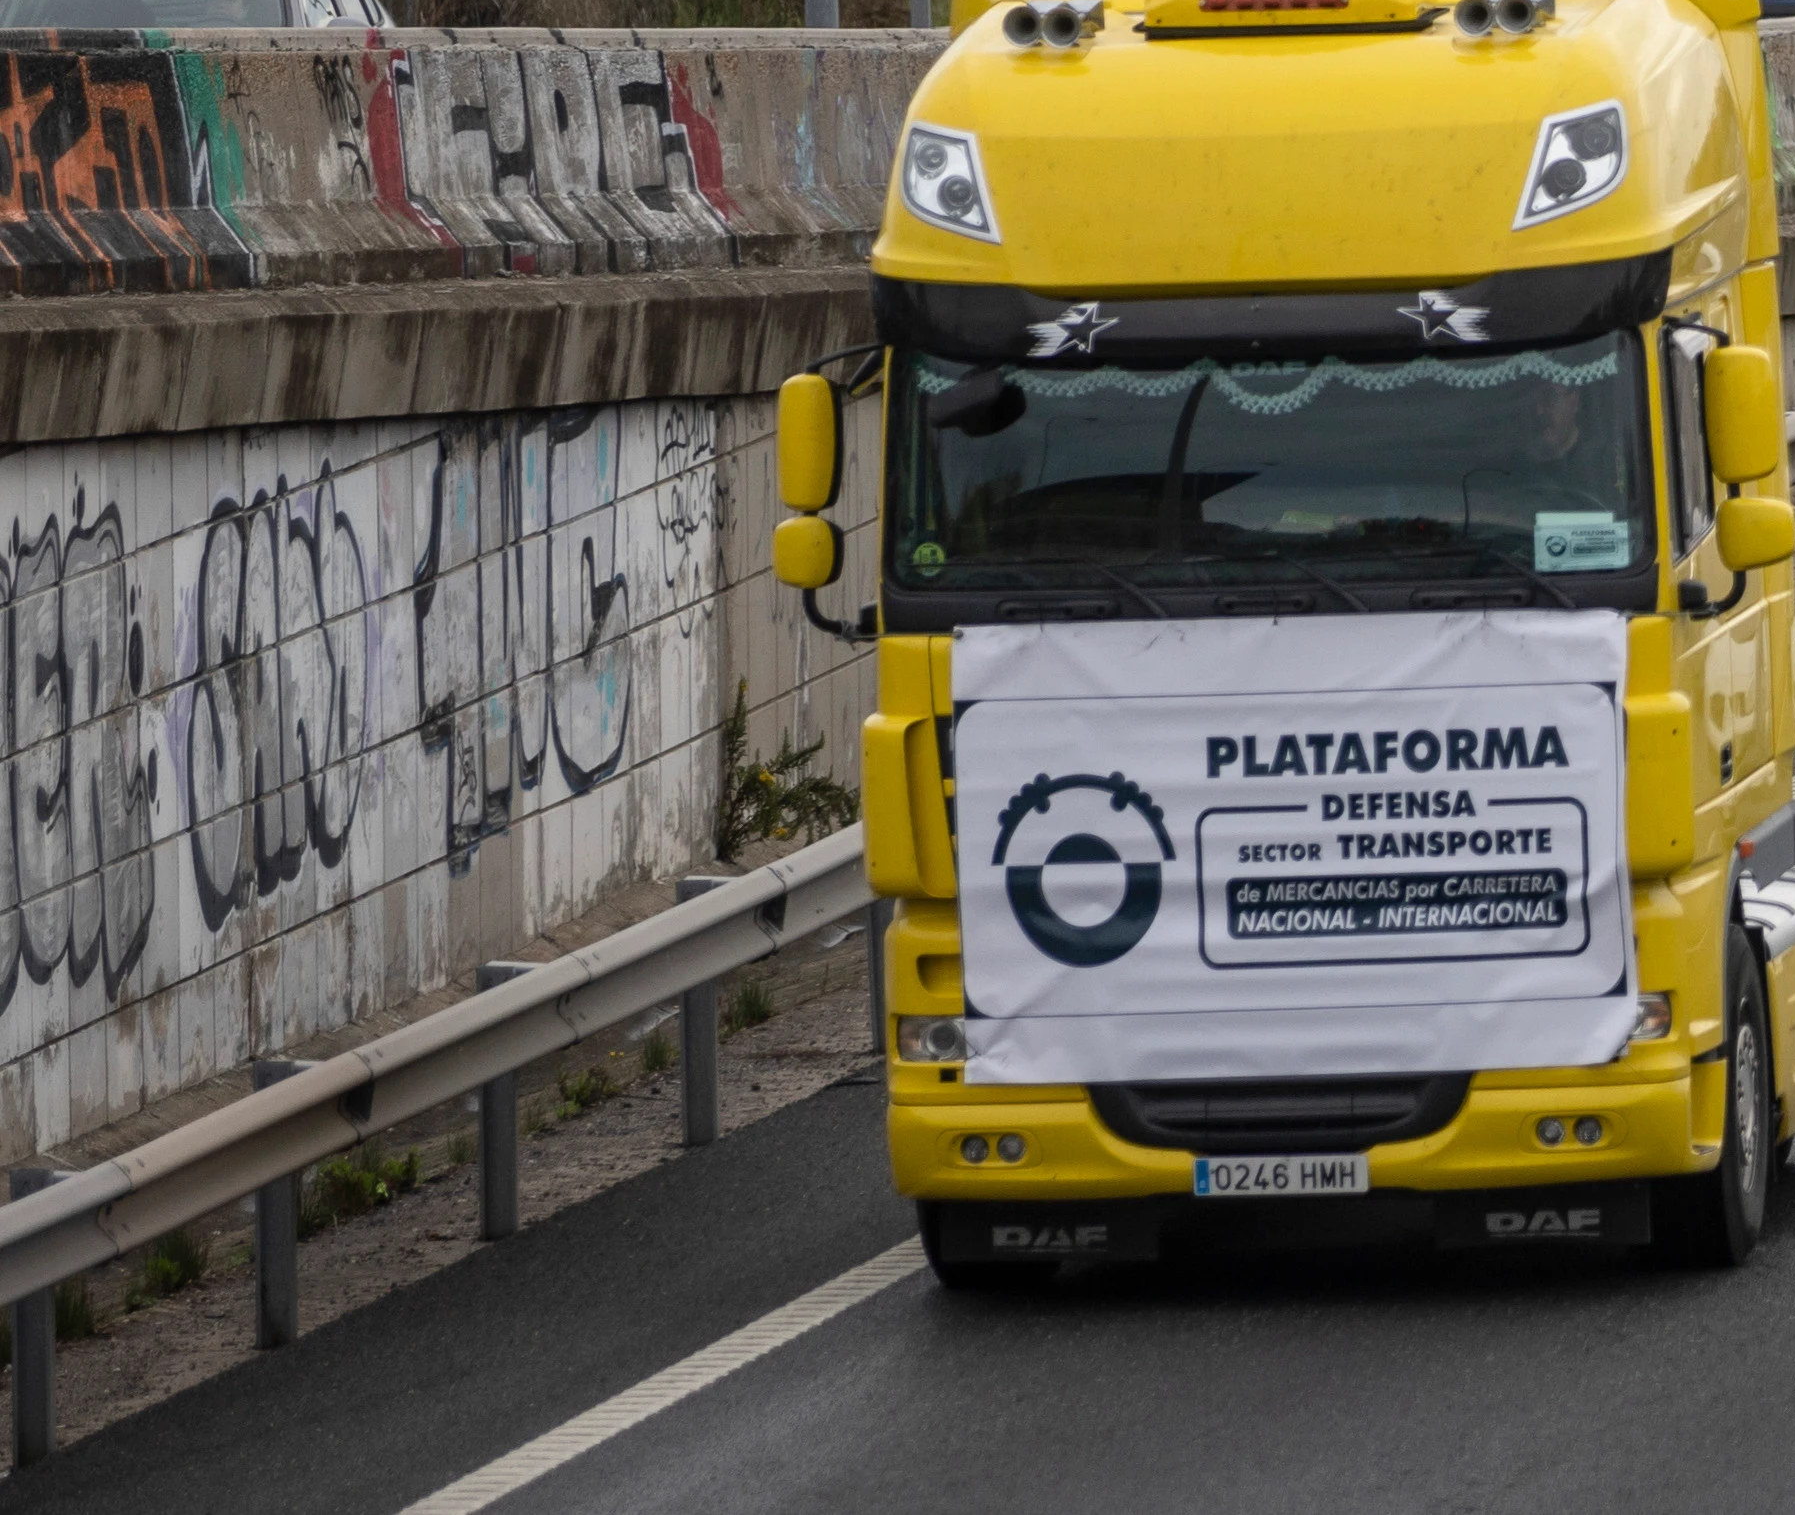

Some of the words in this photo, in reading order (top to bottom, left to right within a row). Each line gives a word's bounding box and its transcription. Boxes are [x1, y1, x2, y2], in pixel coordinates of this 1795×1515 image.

[1206, 725, 1569, 779] PLATAFORMA
[1321, 790, 1476, 822] DEFENSA
[1237, 843, 1322, 864] SECTOR
[1336, 828, 1552, 861] TRANSPORTE
[1236, 882, 1261, 904] de
[1265, 878, 1401, 903] MERCANCIAS
[1404, 879, 1439, 903] por
[1442, 872, 1558, 898] CARRETERA
[1236, 906, 1357, 934] NACIONAL
[1377, 900, 1559, 929] INTERNACIONAL
[1211, 1162, 1290, 1192] 0246
[1300, 1160, 1356, 1190] HMH
[991, 1224, 1108, 1250] DAF
[1486, 1208, 1601, 1235] DAF
